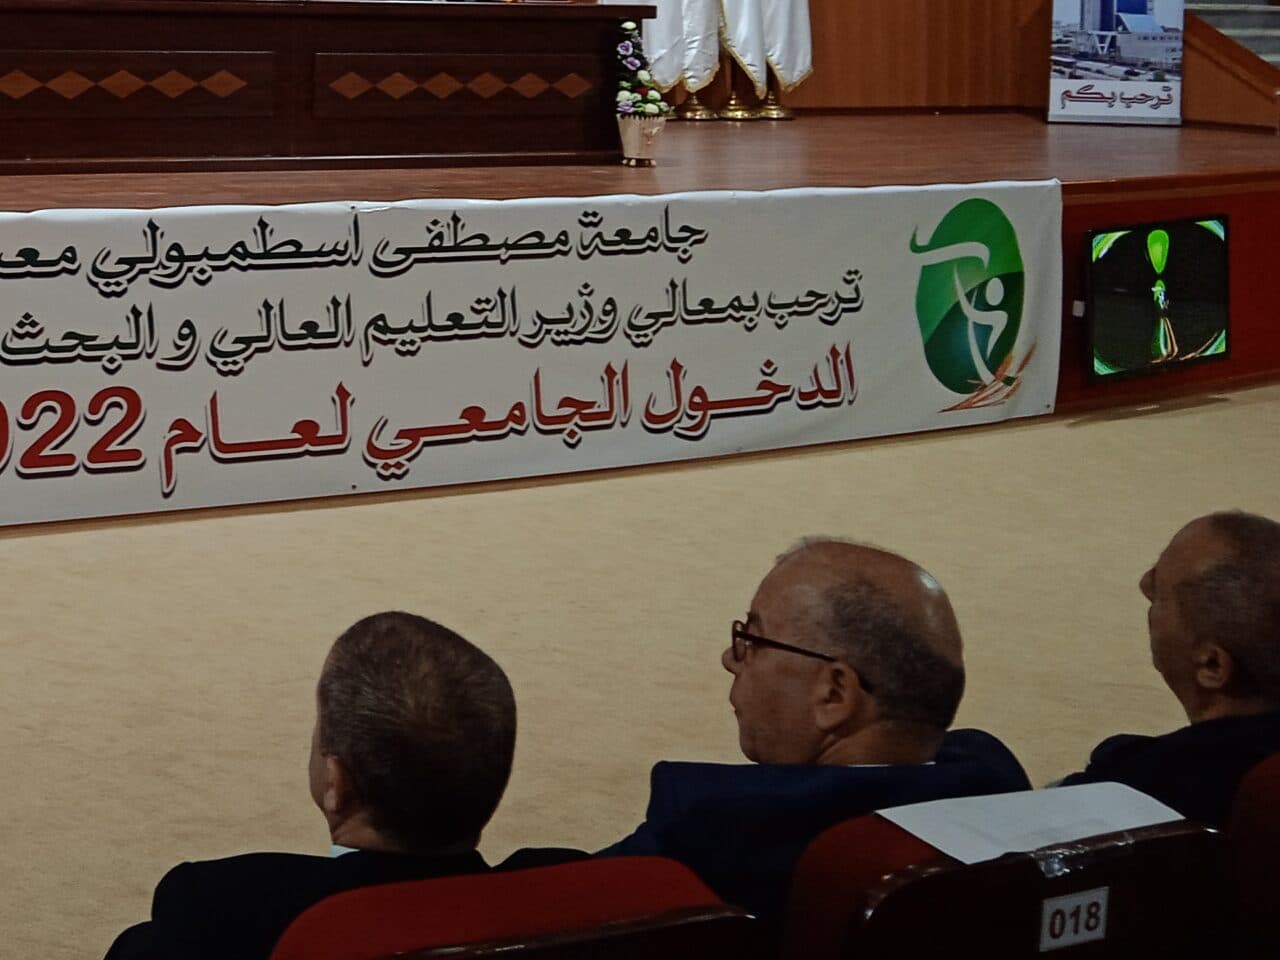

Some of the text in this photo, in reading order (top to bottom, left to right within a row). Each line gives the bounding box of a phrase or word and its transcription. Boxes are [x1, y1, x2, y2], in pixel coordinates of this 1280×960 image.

[87, 212, 363, 296] اسطمبولي
[368, 211, 573, 277] مصطفى
[577, 205, 709, 263] جامعة
[207, 288, 355, 376] العالي
[361, 285, 518, 367] التعليم
[519, 282, 620, 347] وزير
[624, 277, 761, 347] بمعالي
[765, 269, 863, 330] ترحب
[361, 360, 633, 482] الجامعي
[641, 341, 858, 440] الدخول
[156, 381, 357, 496] لعام
[1049, 901, 1101, 940] 018
